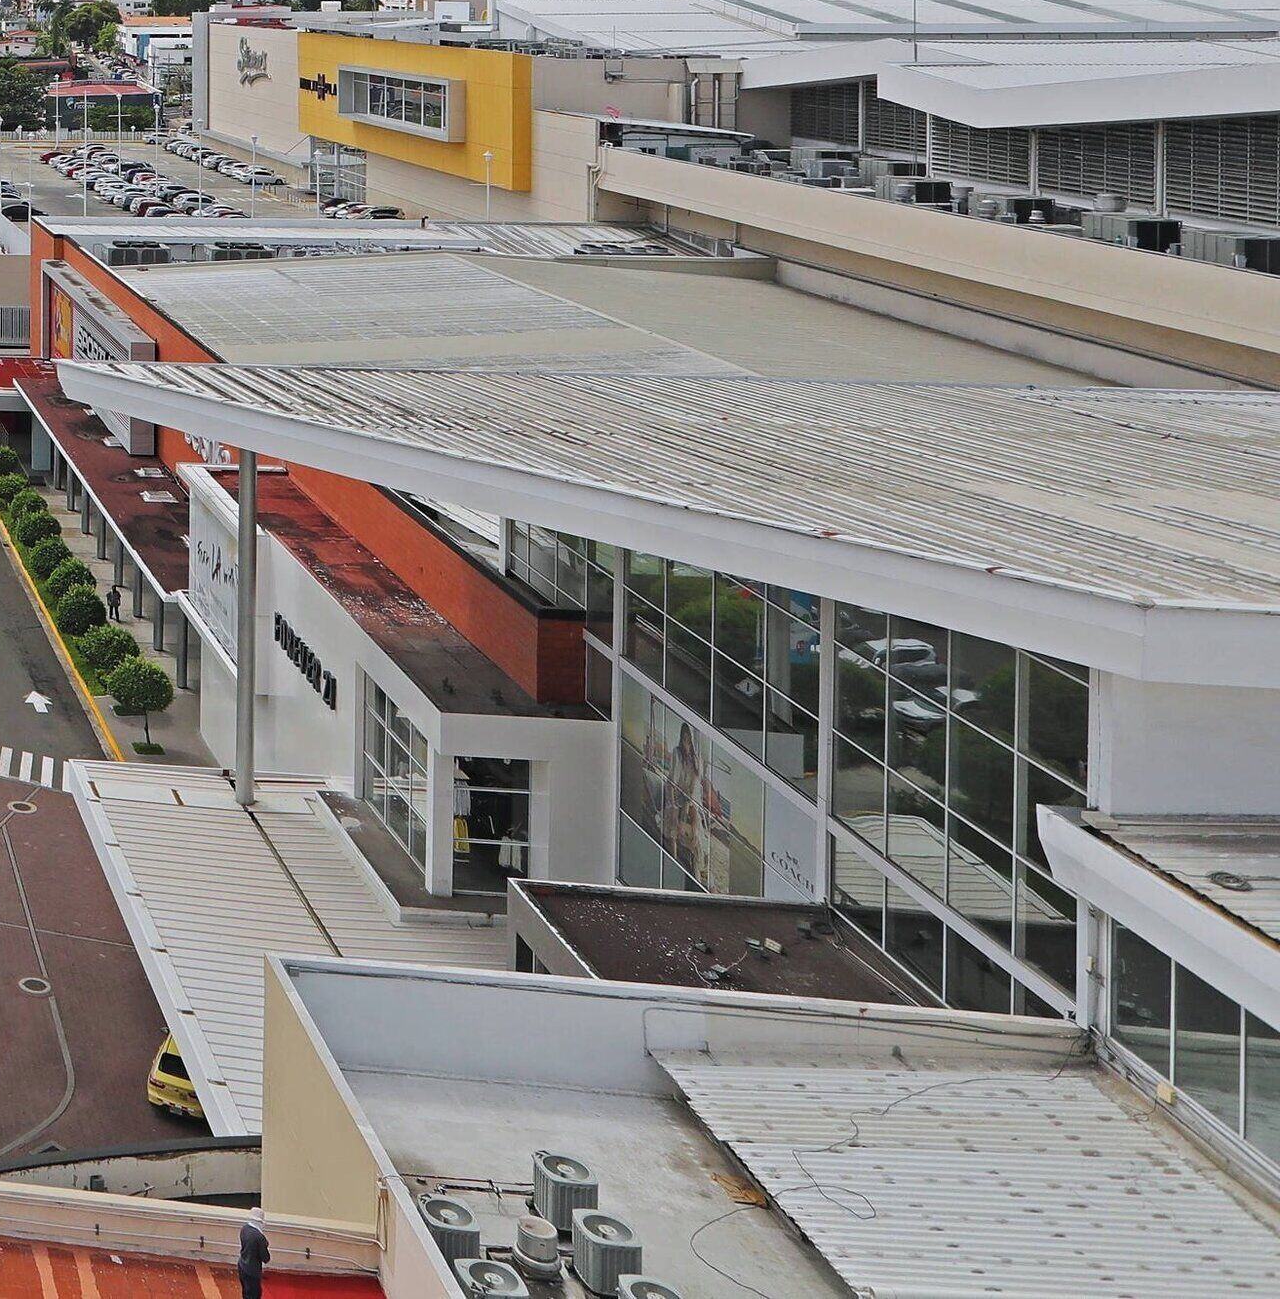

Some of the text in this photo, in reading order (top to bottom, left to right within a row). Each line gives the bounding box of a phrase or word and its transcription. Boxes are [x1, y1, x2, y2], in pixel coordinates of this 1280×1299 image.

[274, 611, 337, 711] FOREVER 21
[771, 851, 814, 895] COACH
